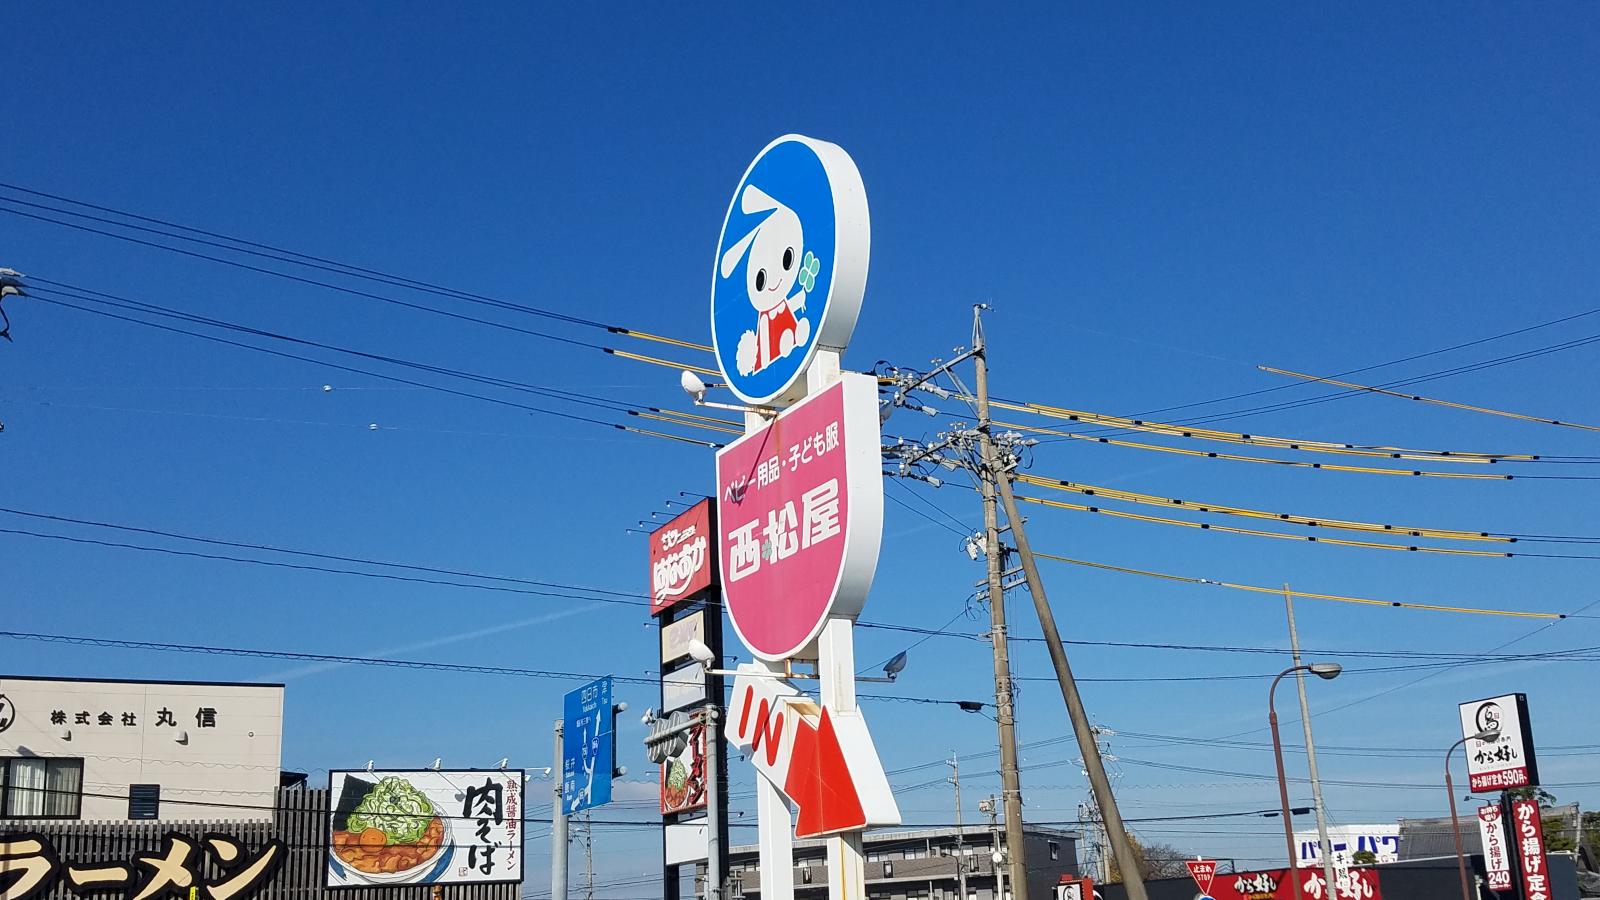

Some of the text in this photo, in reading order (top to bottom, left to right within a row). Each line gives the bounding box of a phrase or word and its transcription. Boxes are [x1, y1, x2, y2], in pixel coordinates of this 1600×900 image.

[728, 477, 841, 583] 西松屋
[51, 707, 217, 728] 株式会社 丸信
[1474, 745, 1518, 764] から好し
[462, 777, 504, 876] 肉そば
[1486, 822, 1503, 870] から揚げ
[0, 835, 280, 900] ラーメン
[1488, 871, 1510, 885] 240
